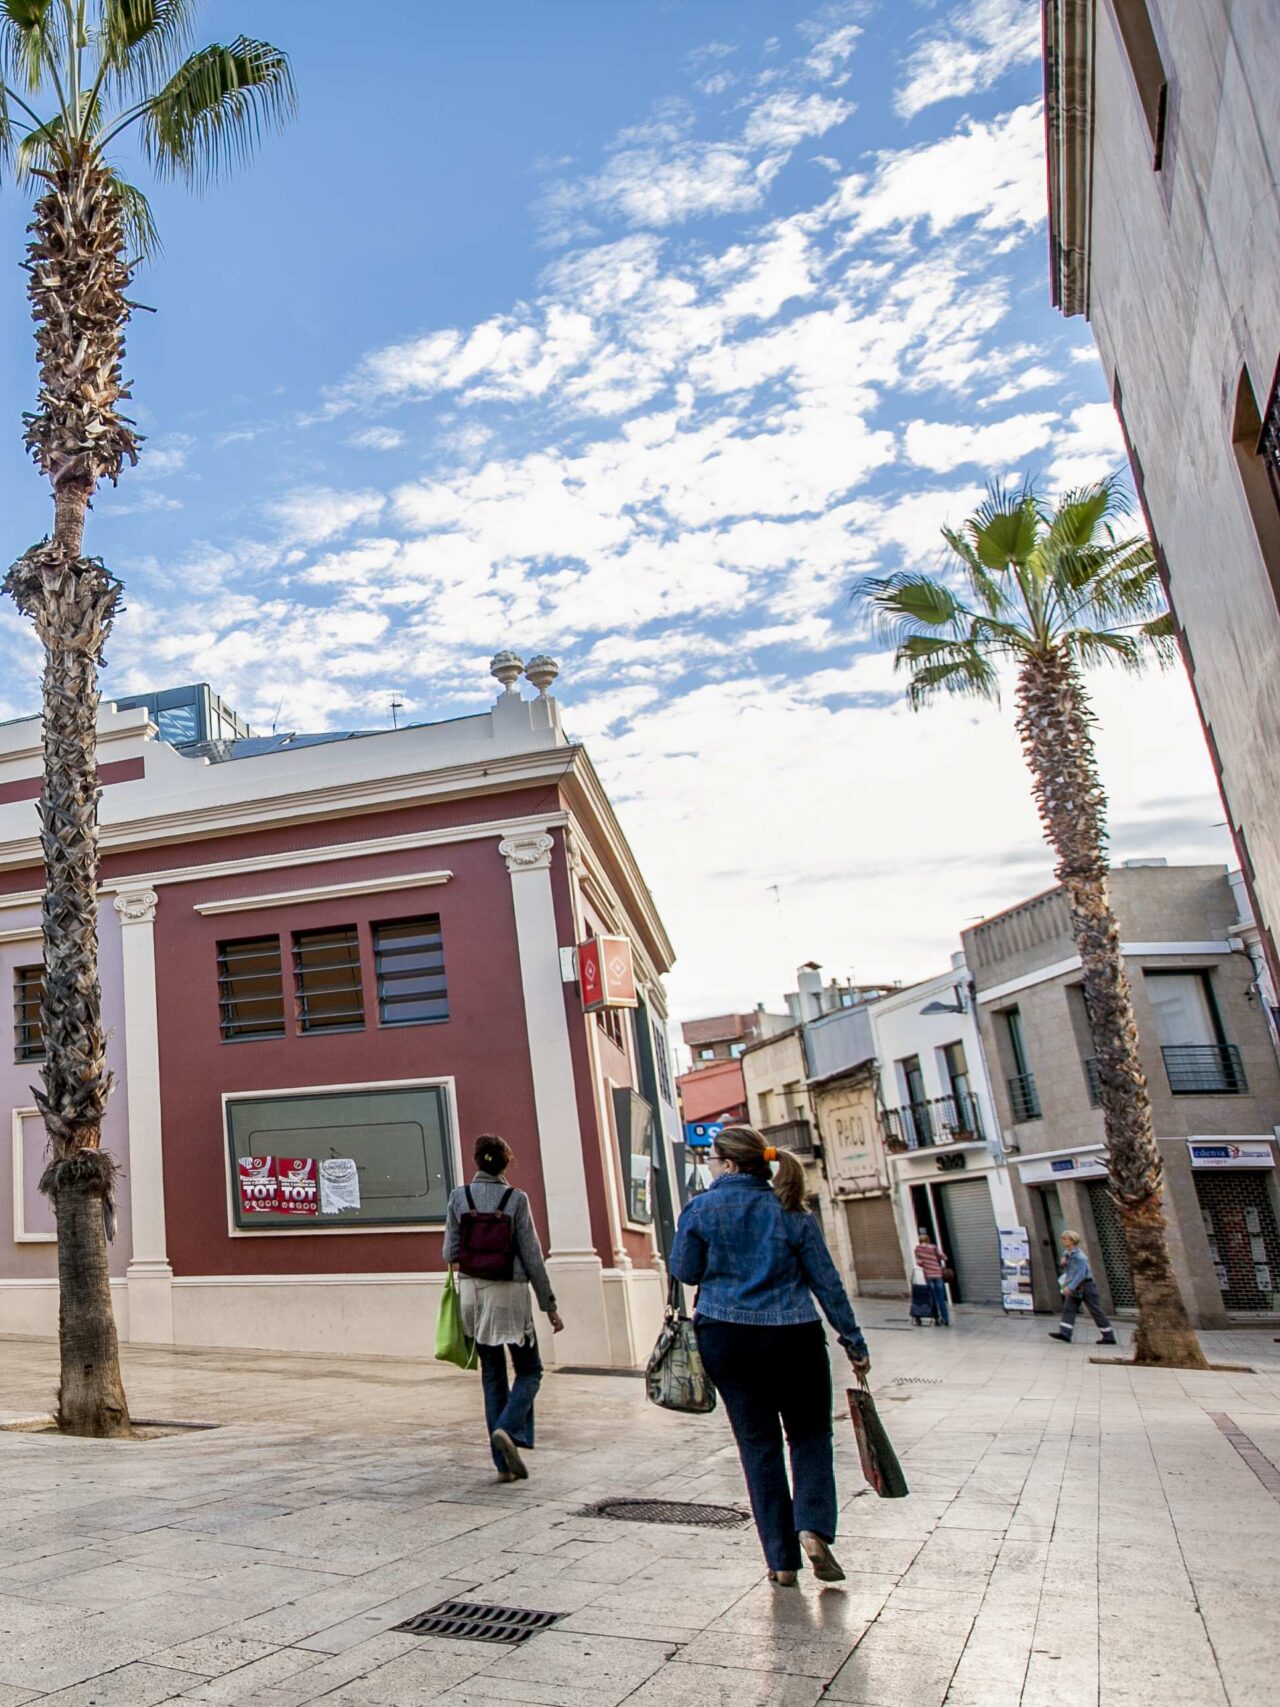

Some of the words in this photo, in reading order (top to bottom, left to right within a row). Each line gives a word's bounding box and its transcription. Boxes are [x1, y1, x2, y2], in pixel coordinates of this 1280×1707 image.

[836, 1116, 866, 1148] PACO
[242, 1184, 278, 1199] TOT
[281, 1186, 317, 1201] TOT
